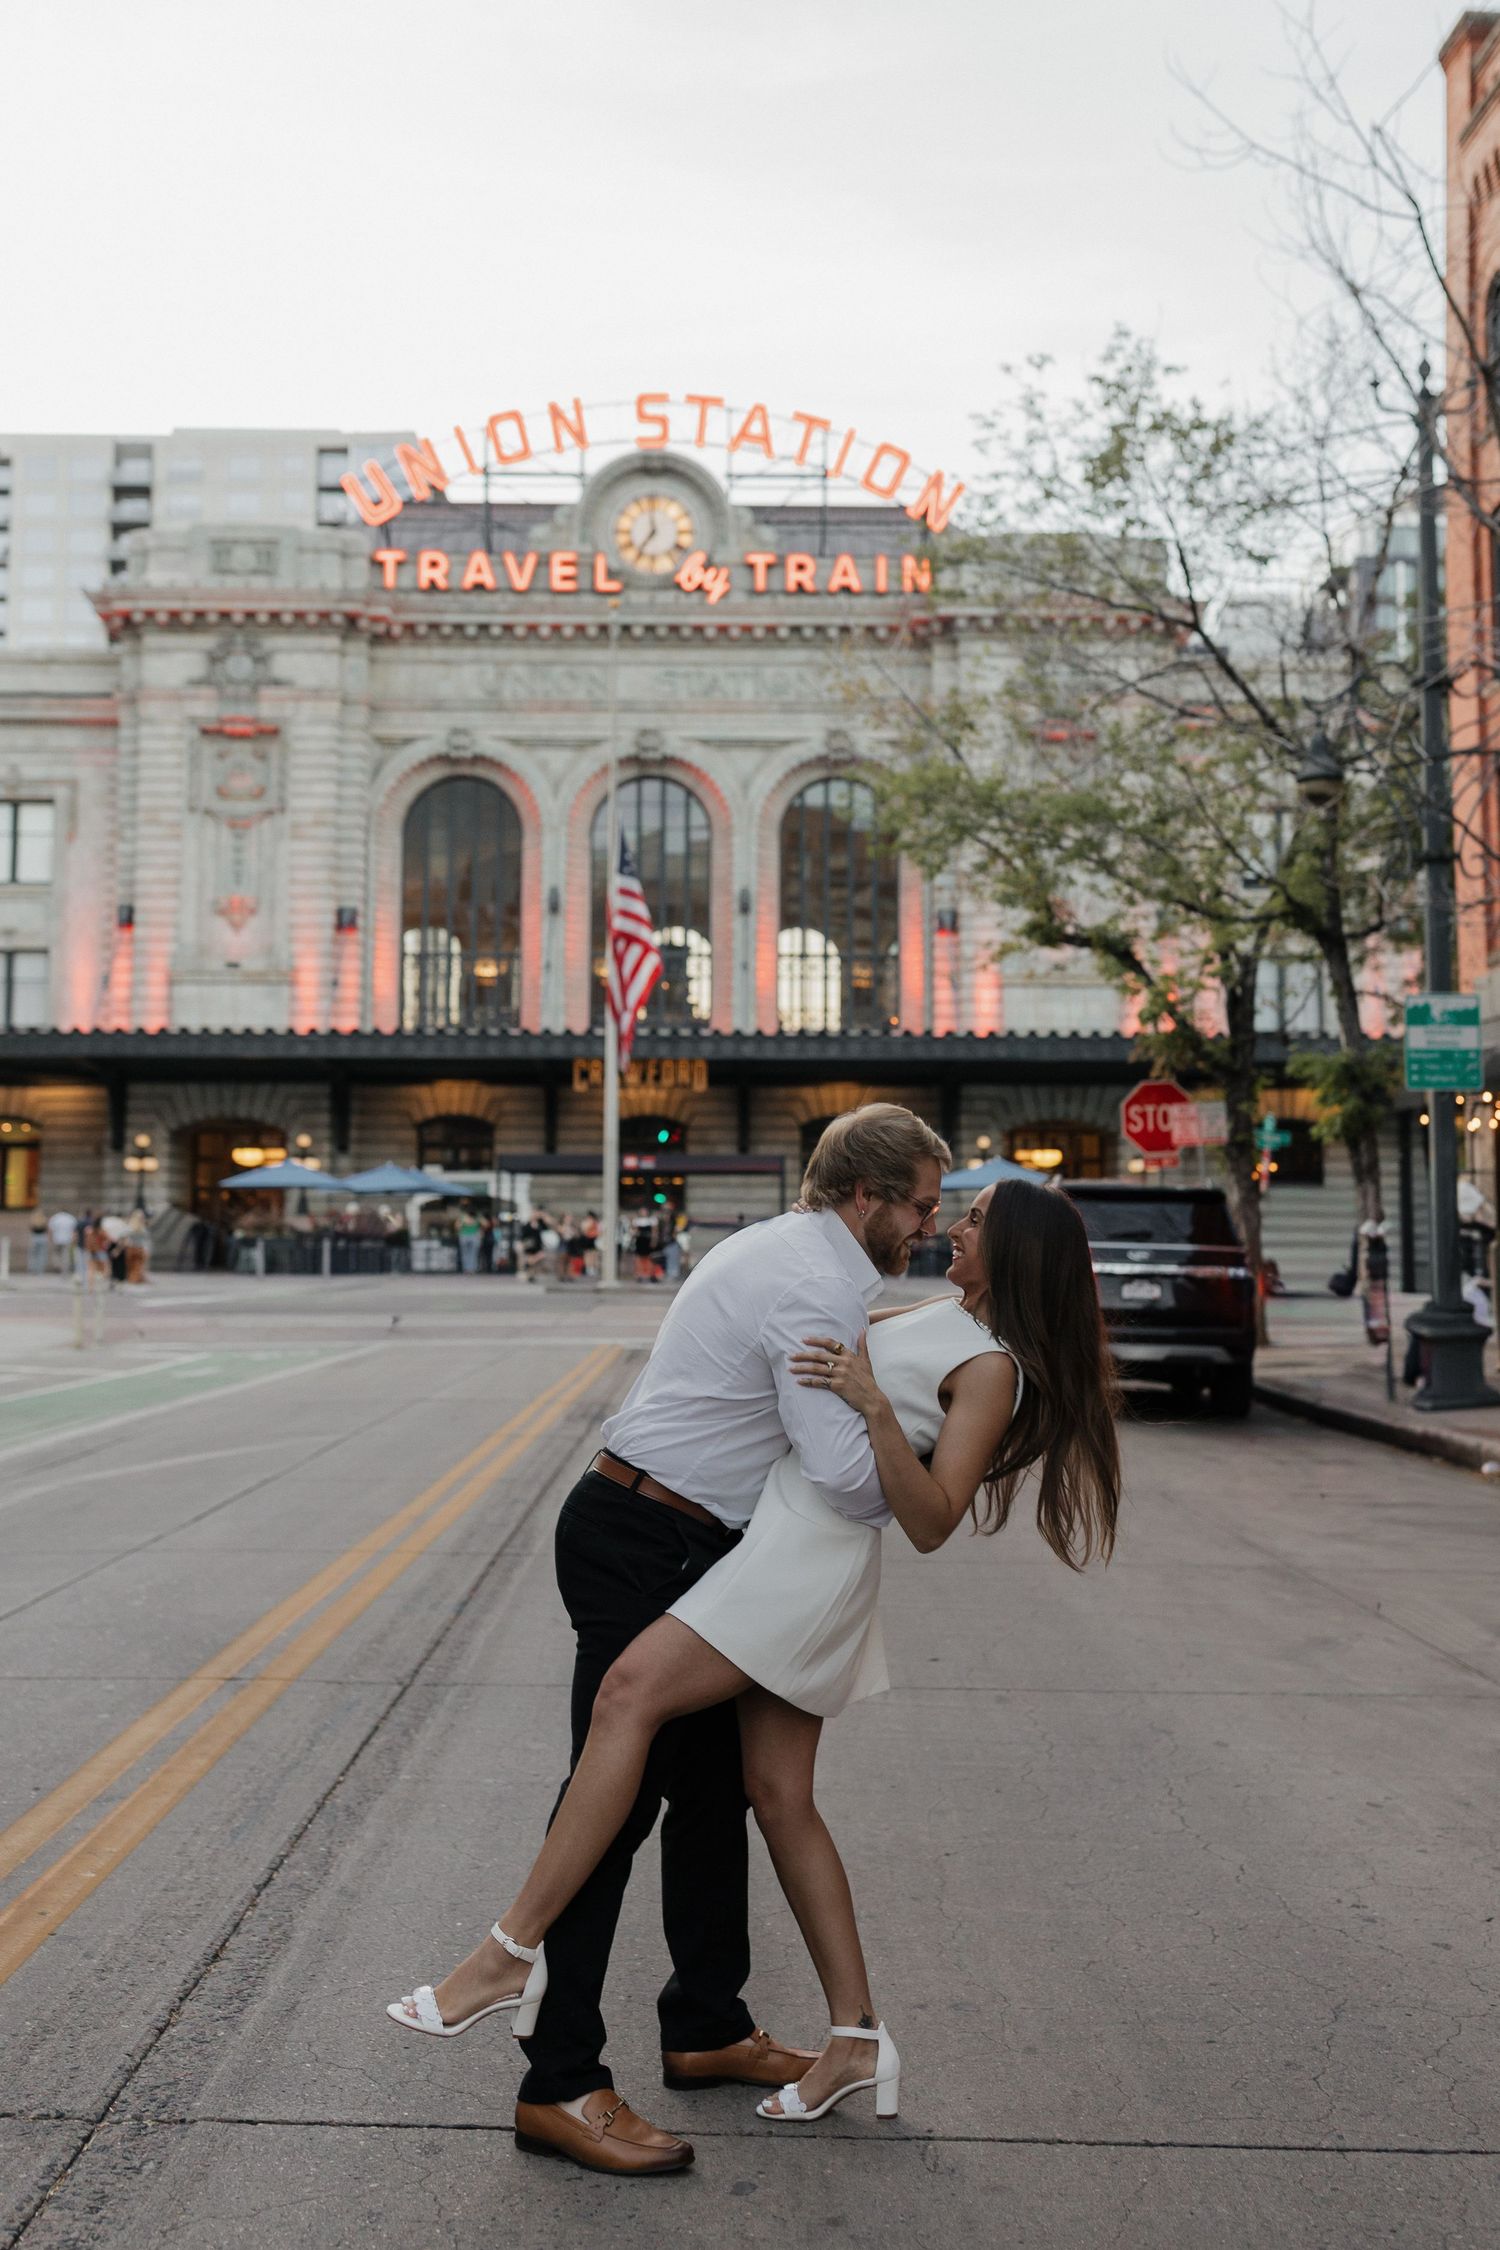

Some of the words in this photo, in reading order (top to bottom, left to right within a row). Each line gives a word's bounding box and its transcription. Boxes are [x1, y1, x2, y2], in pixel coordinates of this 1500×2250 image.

[339, 397, 589, 526] UNION
[635, 392, 966, 533] STATION
[373, 549, 623, 593] TRAVEL
[674, 550, 730, 604] by
[744, 553, 932, 593] TRAIN
[1127, 1103, 1177, 1134] STO
